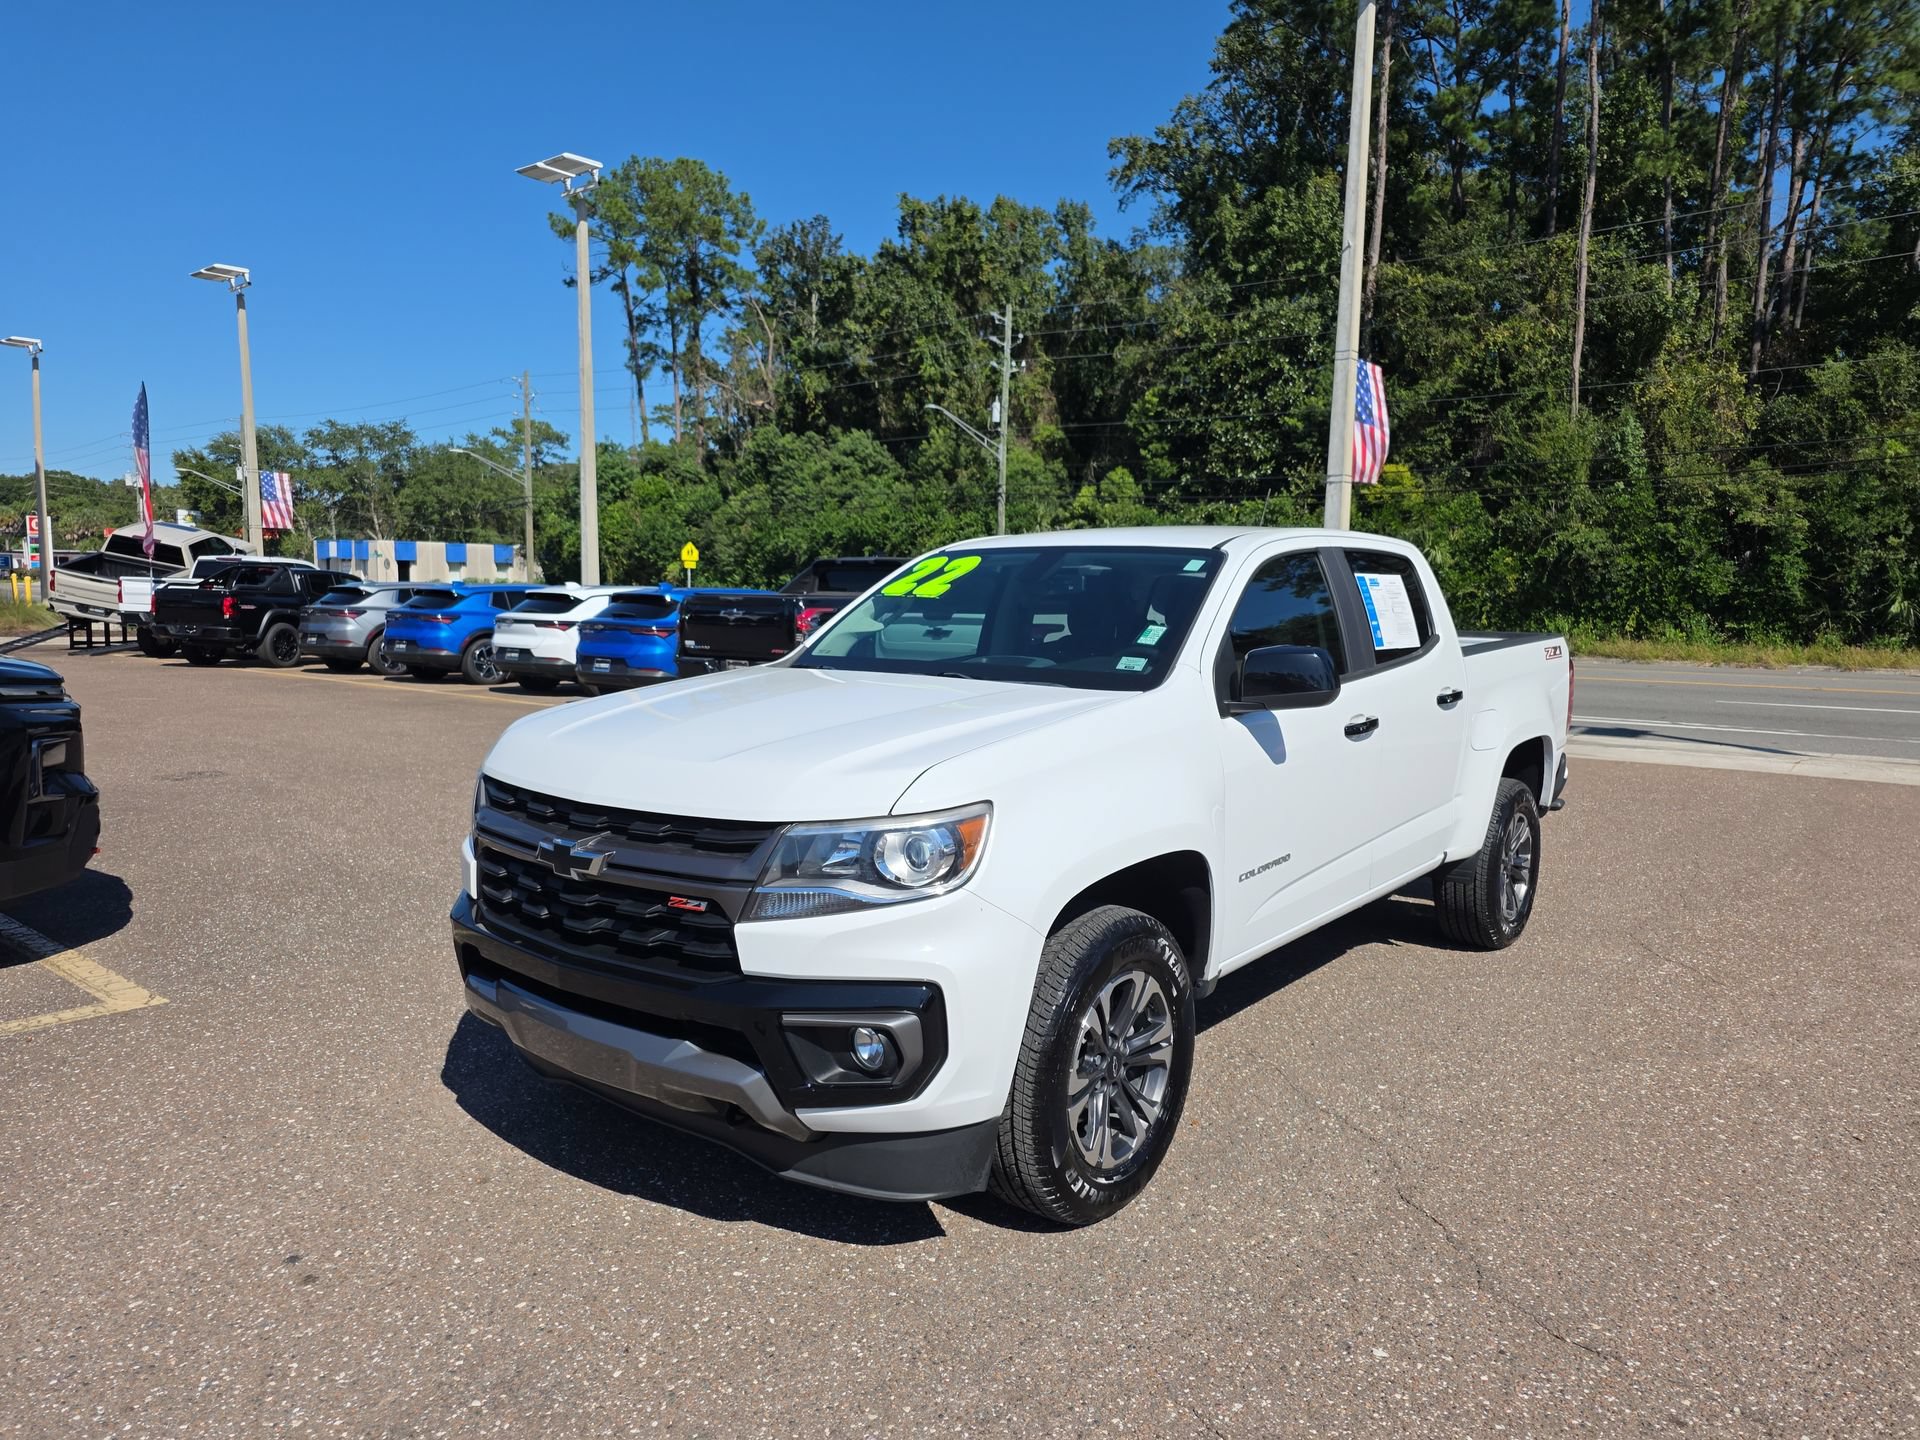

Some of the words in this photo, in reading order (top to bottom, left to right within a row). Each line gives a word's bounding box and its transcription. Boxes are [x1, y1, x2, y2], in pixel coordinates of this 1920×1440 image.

[880, 556, 982, 599] 22
[1544, 645, 1563, 660] Z71
[1238, 853, 1291, 883] COLORADO
[668, 896, 708, 912] Z71
